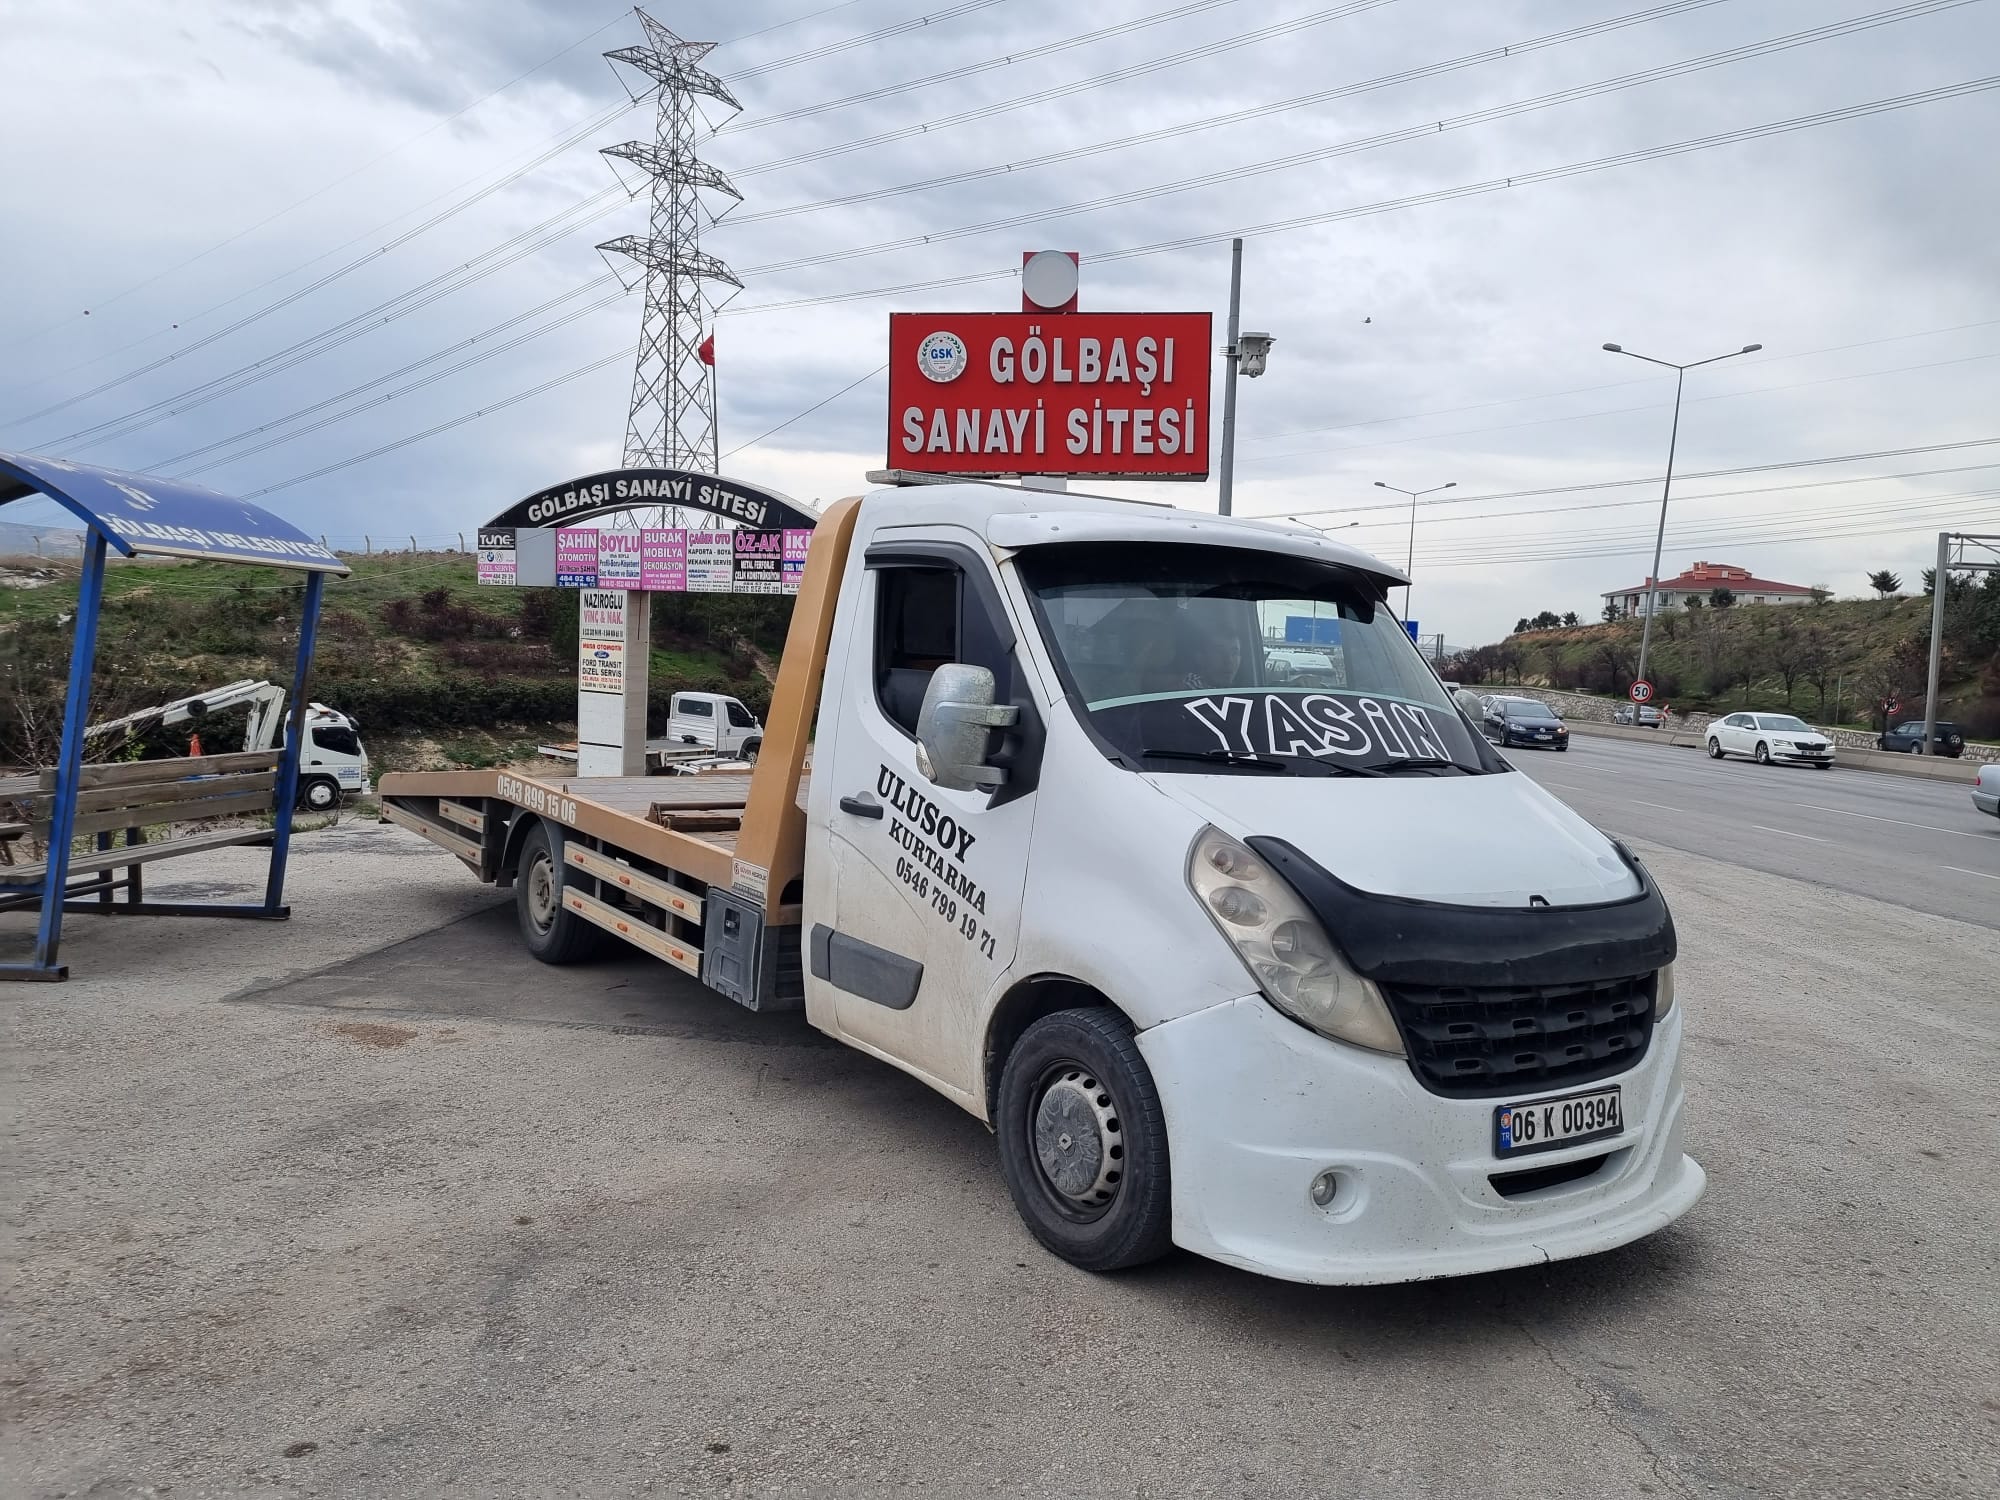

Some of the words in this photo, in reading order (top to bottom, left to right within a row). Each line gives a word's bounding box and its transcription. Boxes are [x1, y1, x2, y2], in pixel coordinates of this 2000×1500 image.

[931, 348, 953, 360] GSK
[989, 325, 1174, 396] GÖLBAŞI
[902, 398, 1045, 454] SANAYİ
[1065, 398, 1195, 455] SİTESİ
[528, 482, 610, 522] GÖLBAŞI
[615, 477, 692, 501] SANAYİ
[698, 483, 768, 525] SİTESİ
[207, 531, 338, 560] BELEDİYESİ
[558, 530, 597, 552] ŞAHİN
[599, 534, 641, 553] SOYLU
[644, 532, 683, 544] BURAK
[714, 533, 731, 545] OTO
[735, 531, 781, 552] ÖZ-AK
[558, 551, 597, 562] OTOMOTİV
[643, 547, 683, 558] MOBİLYA
[687, 558, 712, 566] MEKANİK
[643, 561, 684, 571] DEKORASYON
[583, 591, 624, 610] NAZİROĞLU
[582, 658, 597, 667] FORD
[1633, 686, 1649, 698] 50
[497, 775, 523, 803] 0543
[524, 784, 545, 812] 899
[546, 794, 560, 818] 15
[560, 800, 577, 825] 06
[876, 763, 976, 864] ULUSOY
[888, 817, 987, 916] KURTARMA
[896, 856, 929, 899] 0546
[931, 885, 957, 923] 799
[959, 913, 977, 941] 19
[979, 929, 997, 961] 71
[1501, 1132, 1510, 1142] TR
[1512, 1110, 1536, 1143] 06
[1544, 1106, 1555, 1138] K
[1562, 1096, 1618, 1134] 00394
